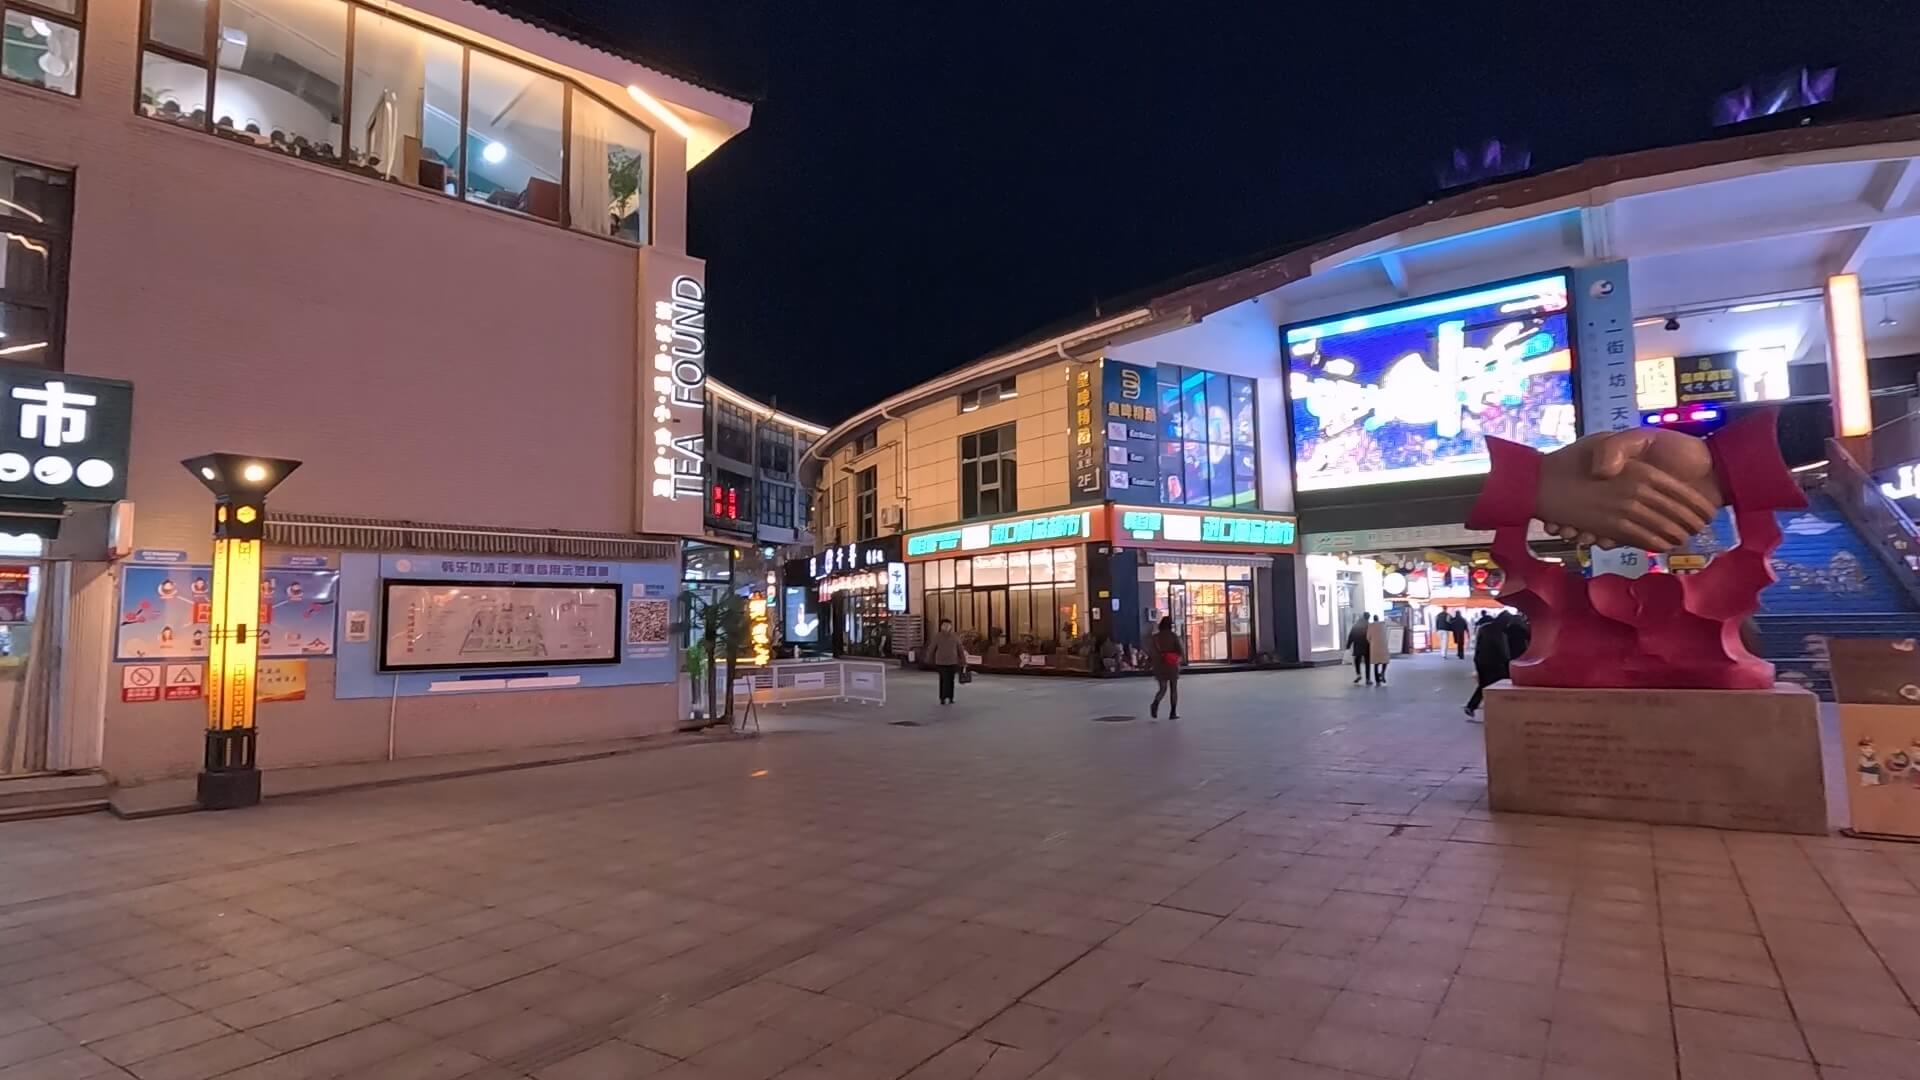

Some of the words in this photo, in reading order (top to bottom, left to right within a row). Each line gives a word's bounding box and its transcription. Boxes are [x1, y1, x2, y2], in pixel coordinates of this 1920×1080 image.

[670, 274, 705, 409] FOUND
[11, 381, 97, 447] 市
[670, 434, 705, 501] TEA
[1077, 473, 1092, 488] 2F
